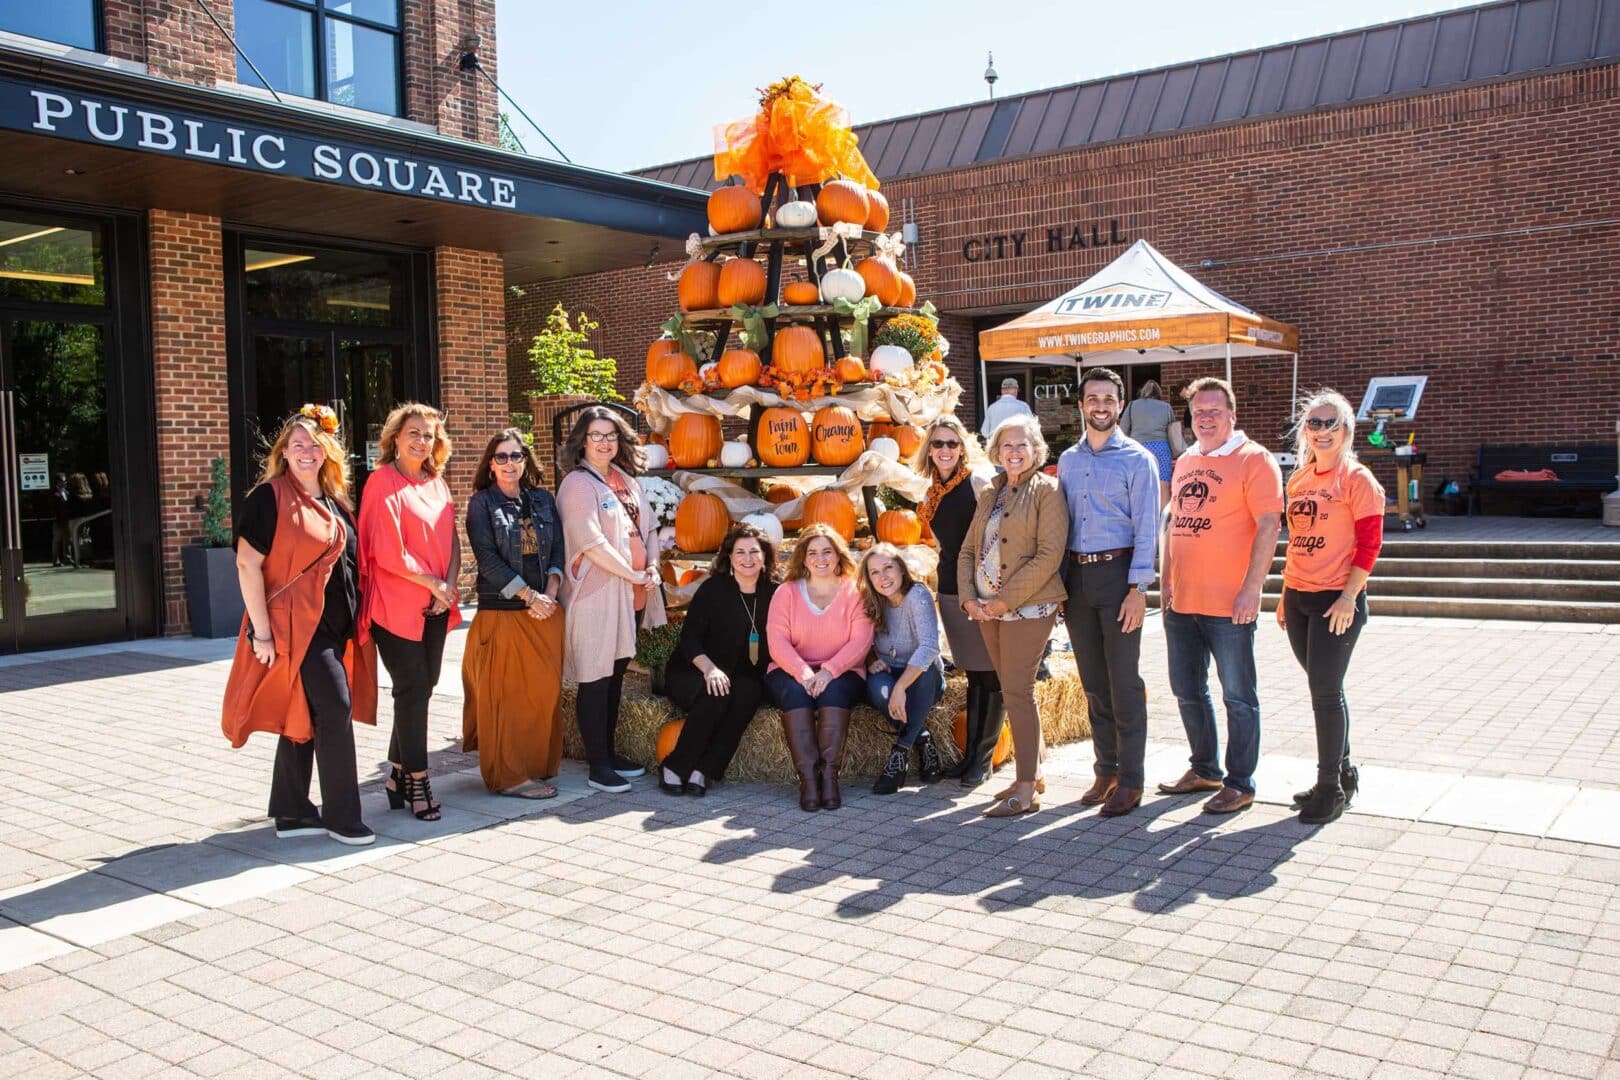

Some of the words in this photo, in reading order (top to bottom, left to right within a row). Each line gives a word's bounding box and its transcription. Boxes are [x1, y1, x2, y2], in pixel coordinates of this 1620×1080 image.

[30, 90, 286, 170] PUBLIC
[312, 144, 517, 208] SQUARE
[963, 232, 1026, 262] CITY
[1047, 219, 1127, 252] HALL
[1065, 293, 1167, 312] TWINE
[1038, 327, 1161, 348] WWW.TWINEGRAPHICS.COM
[1034, 383, 1073, 399] CITY
[768, 417, 798, 435] Paint
[815, 424, 857, 443] Orange
